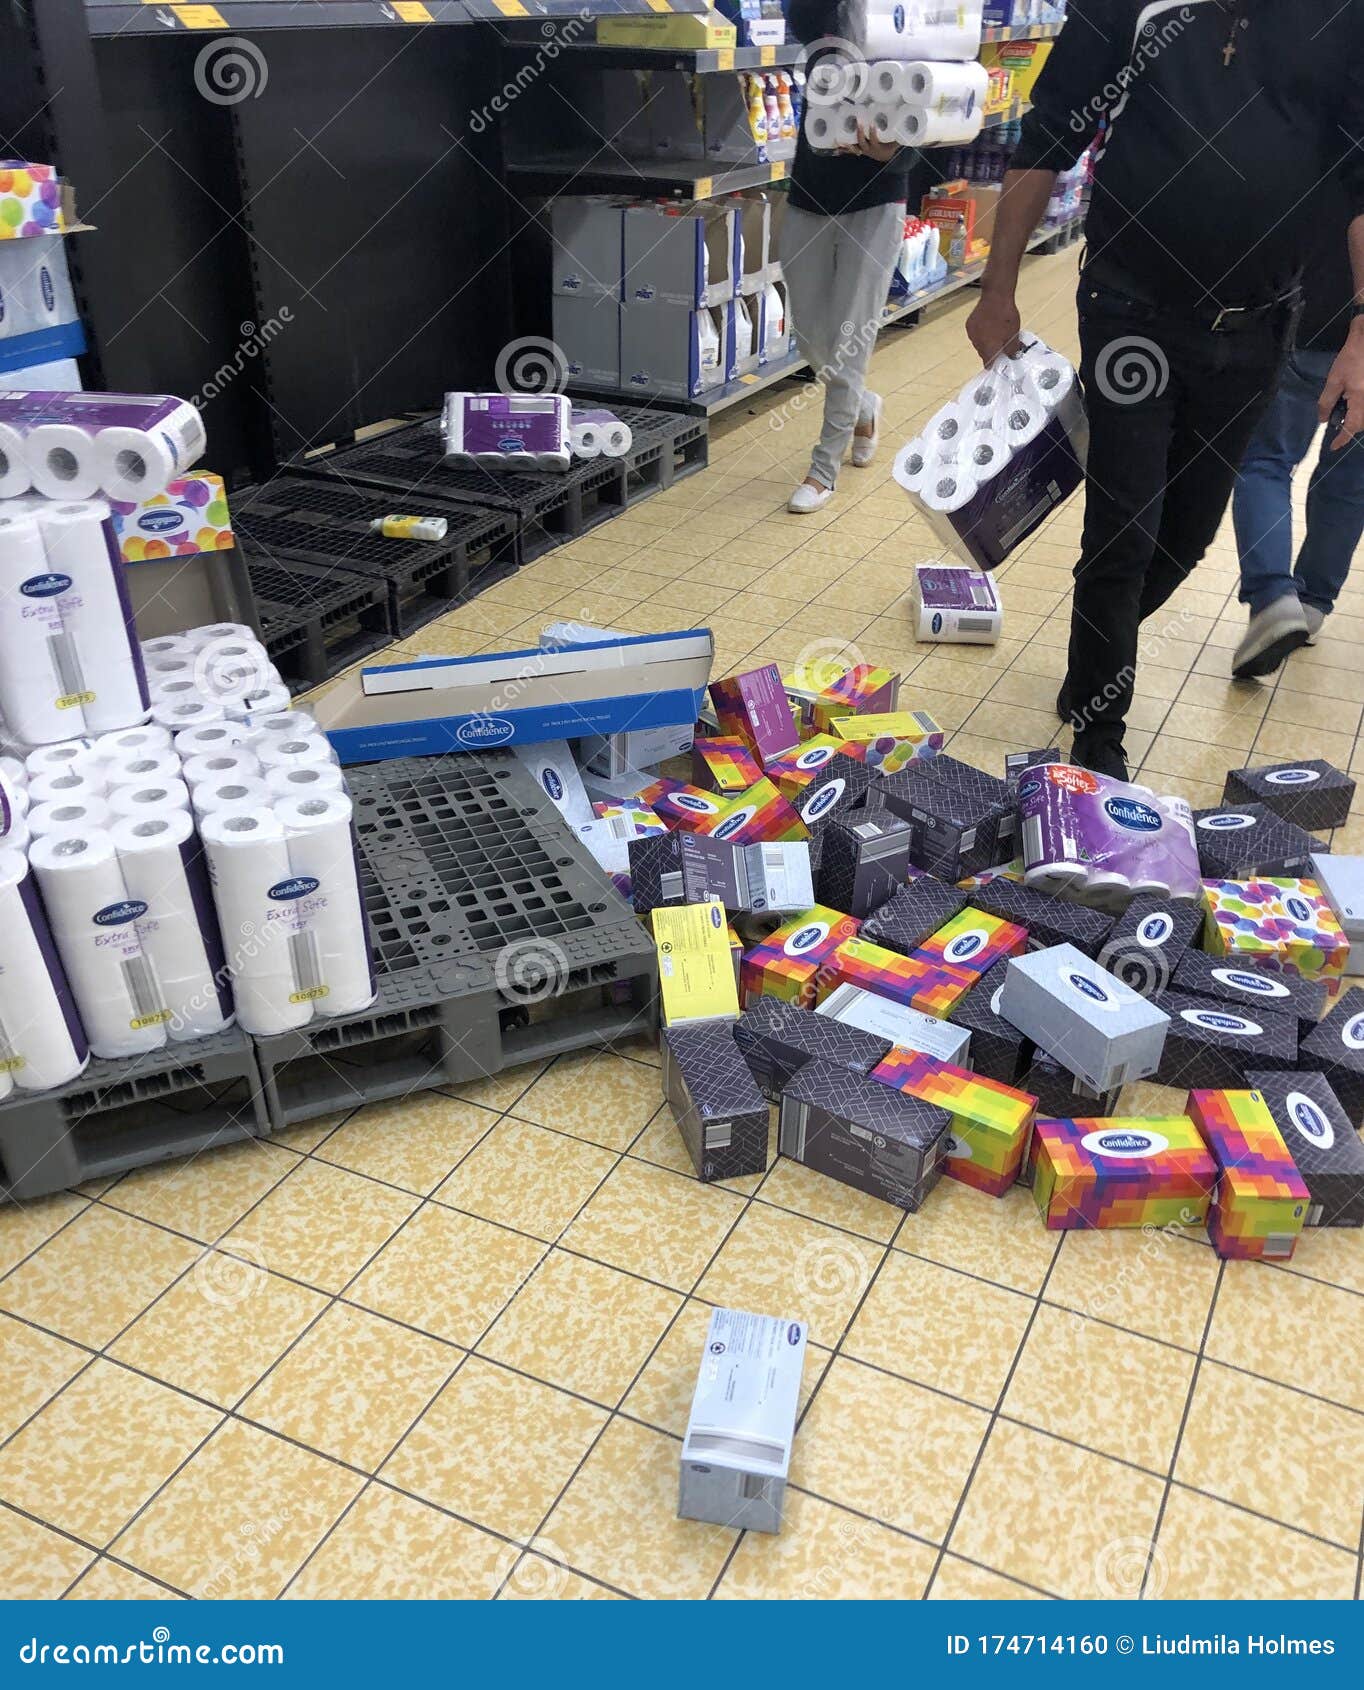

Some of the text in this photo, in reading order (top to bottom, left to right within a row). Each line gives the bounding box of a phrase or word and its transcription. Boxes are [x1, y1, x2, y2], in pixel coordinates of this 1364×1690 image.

[23, 578, 69, 594] Confidence
[21, 606, 54, 618] Extra
[461, 724, 509, 739] Confidence
[1108, 801, 1159, 826] Confidence
[268, 880, 317, 898] Confidence
[95, 904, 145, 922] Confidence
[266, 907, 296, 920] Extra
[94, 931, 128, 946] Extra
[1102, 1136, 1149, 1147] Confidence
